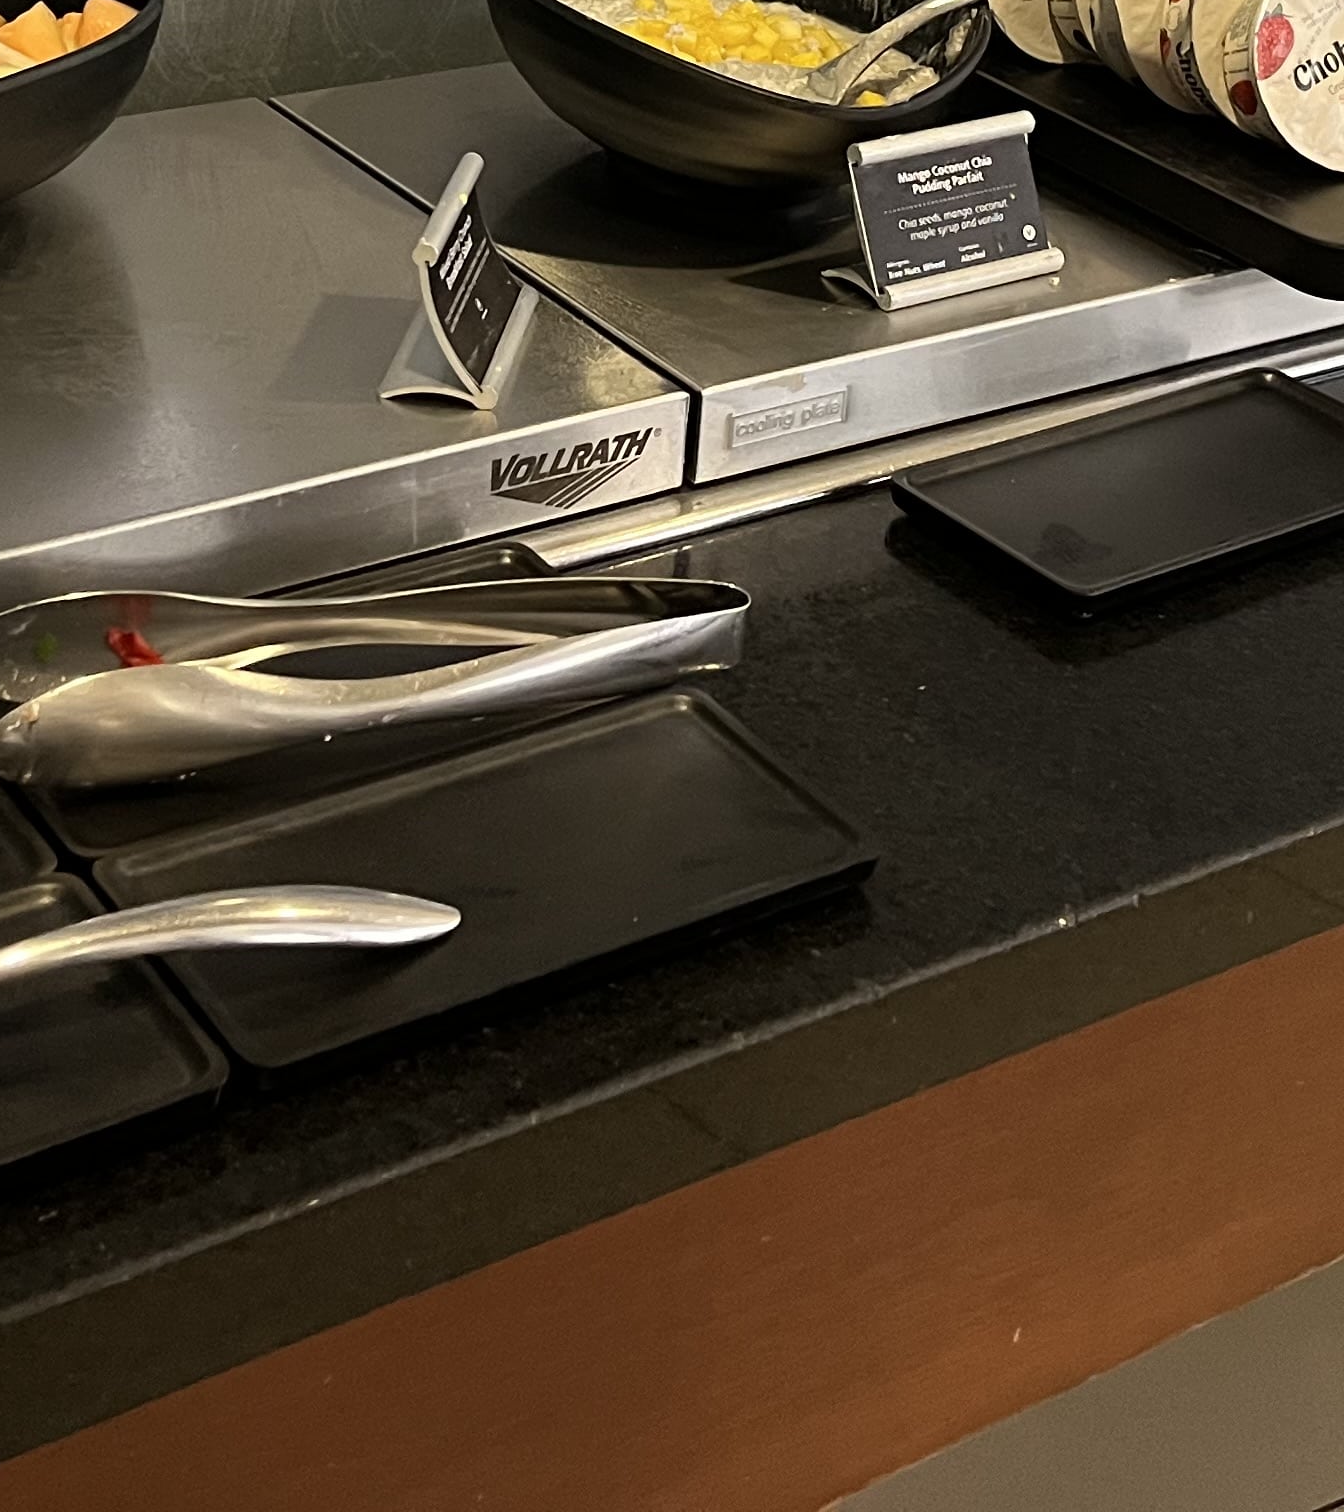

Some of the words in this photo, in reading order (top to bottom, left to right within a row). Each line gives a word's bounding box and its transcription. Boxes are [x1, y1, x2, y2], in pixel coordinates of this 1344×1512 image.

[897, 169, 931, 184] Mango
[931, 159, 971, 177] Coconut
[971, 154, 992, 168] Chia
[912, 177, 952, 194] Pudding
[951, 170, 984, 187] Parfait
[898, 217, 917, 230] Chia
[910, 227, 936, 241] maple
[938, 223, 960, 238] syrup
[960, 218, 977, 230] and
[735, 411, 794, 438] cooling
[801, 397, 842, 426] plate
[491, 427, 654, 491] VOLLRATH
